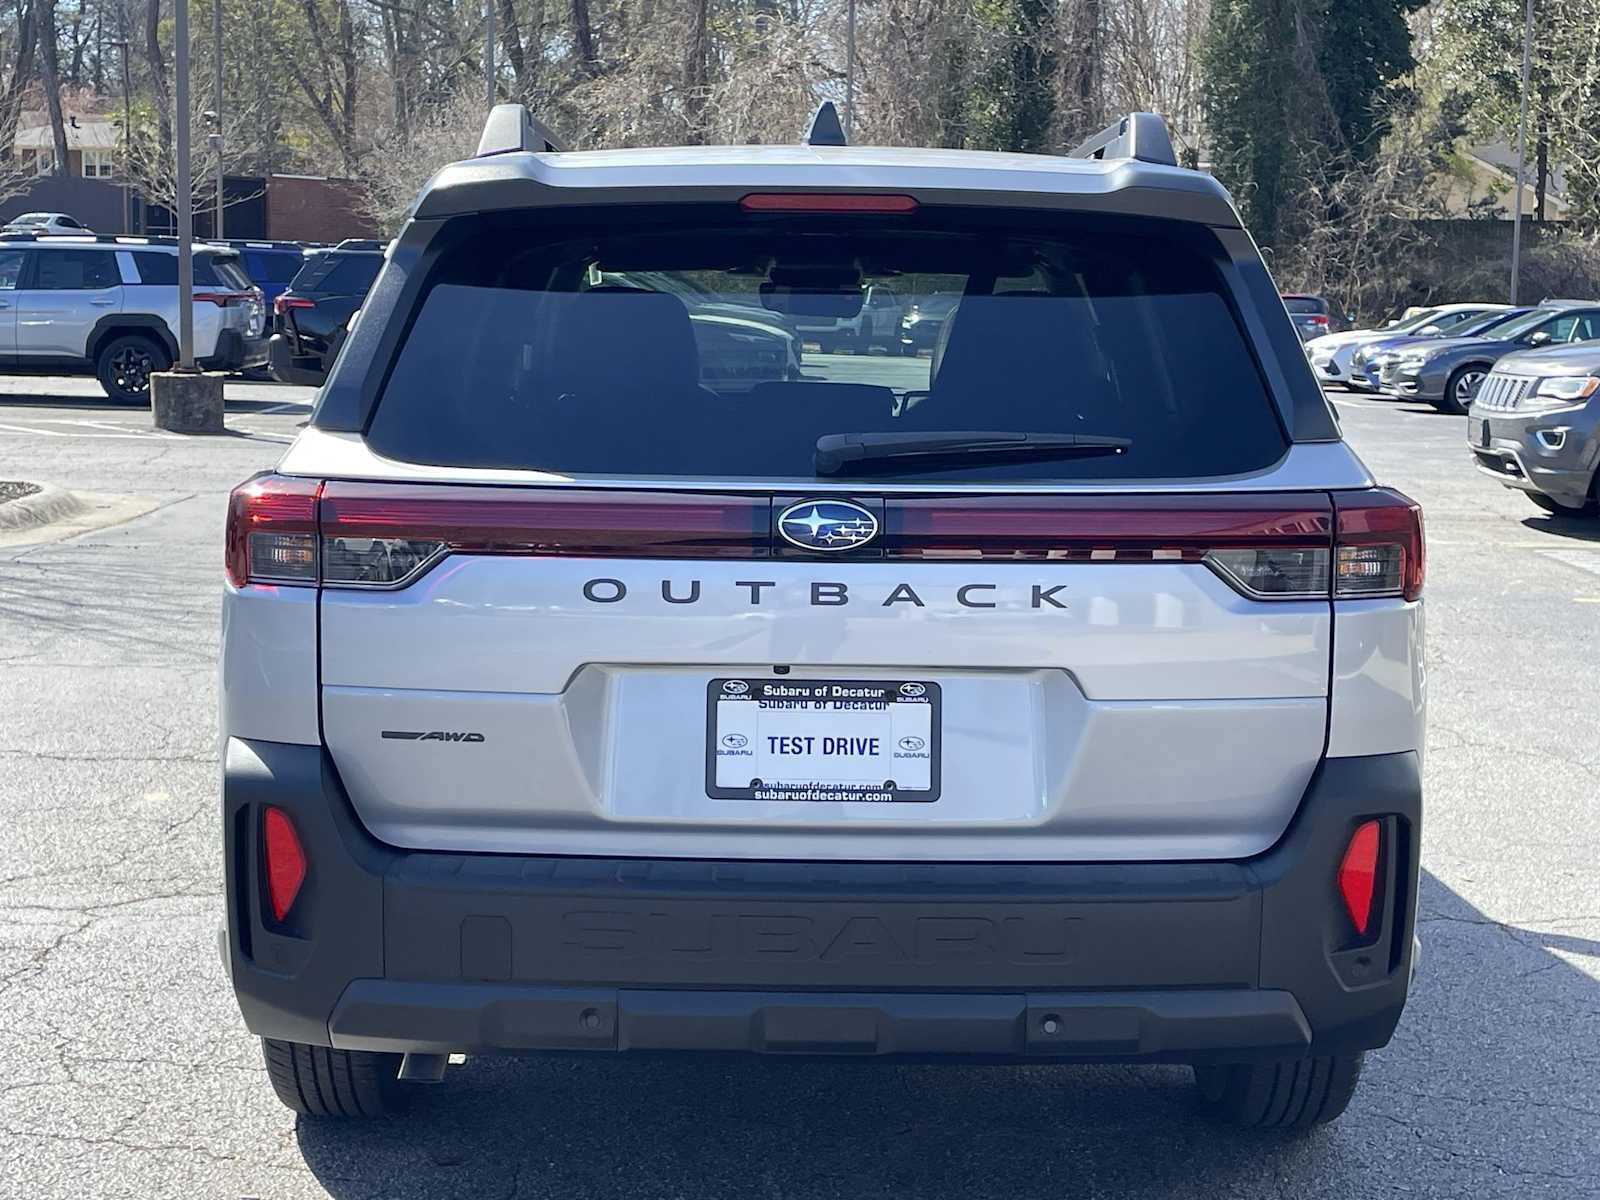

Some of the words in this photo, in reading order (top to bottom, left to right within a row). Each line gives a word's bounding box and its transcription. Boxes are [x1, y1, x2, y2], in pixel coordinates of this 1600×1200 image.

[583, 578, 1069, 609] OUTBACK
[763, 685, 810, 697] Subaru
[815, 685, 828, 697] of
[832, 686, 885, 698] Decatur
[420, 731, 485, 742] AWD
[767, 736, 815, 756] TEST
[823, 737, 880, 757] DRIVE
[754, 790, 893, 802] subaruofdecatur.com
[562, 911, 1082, 966] SUBARU
